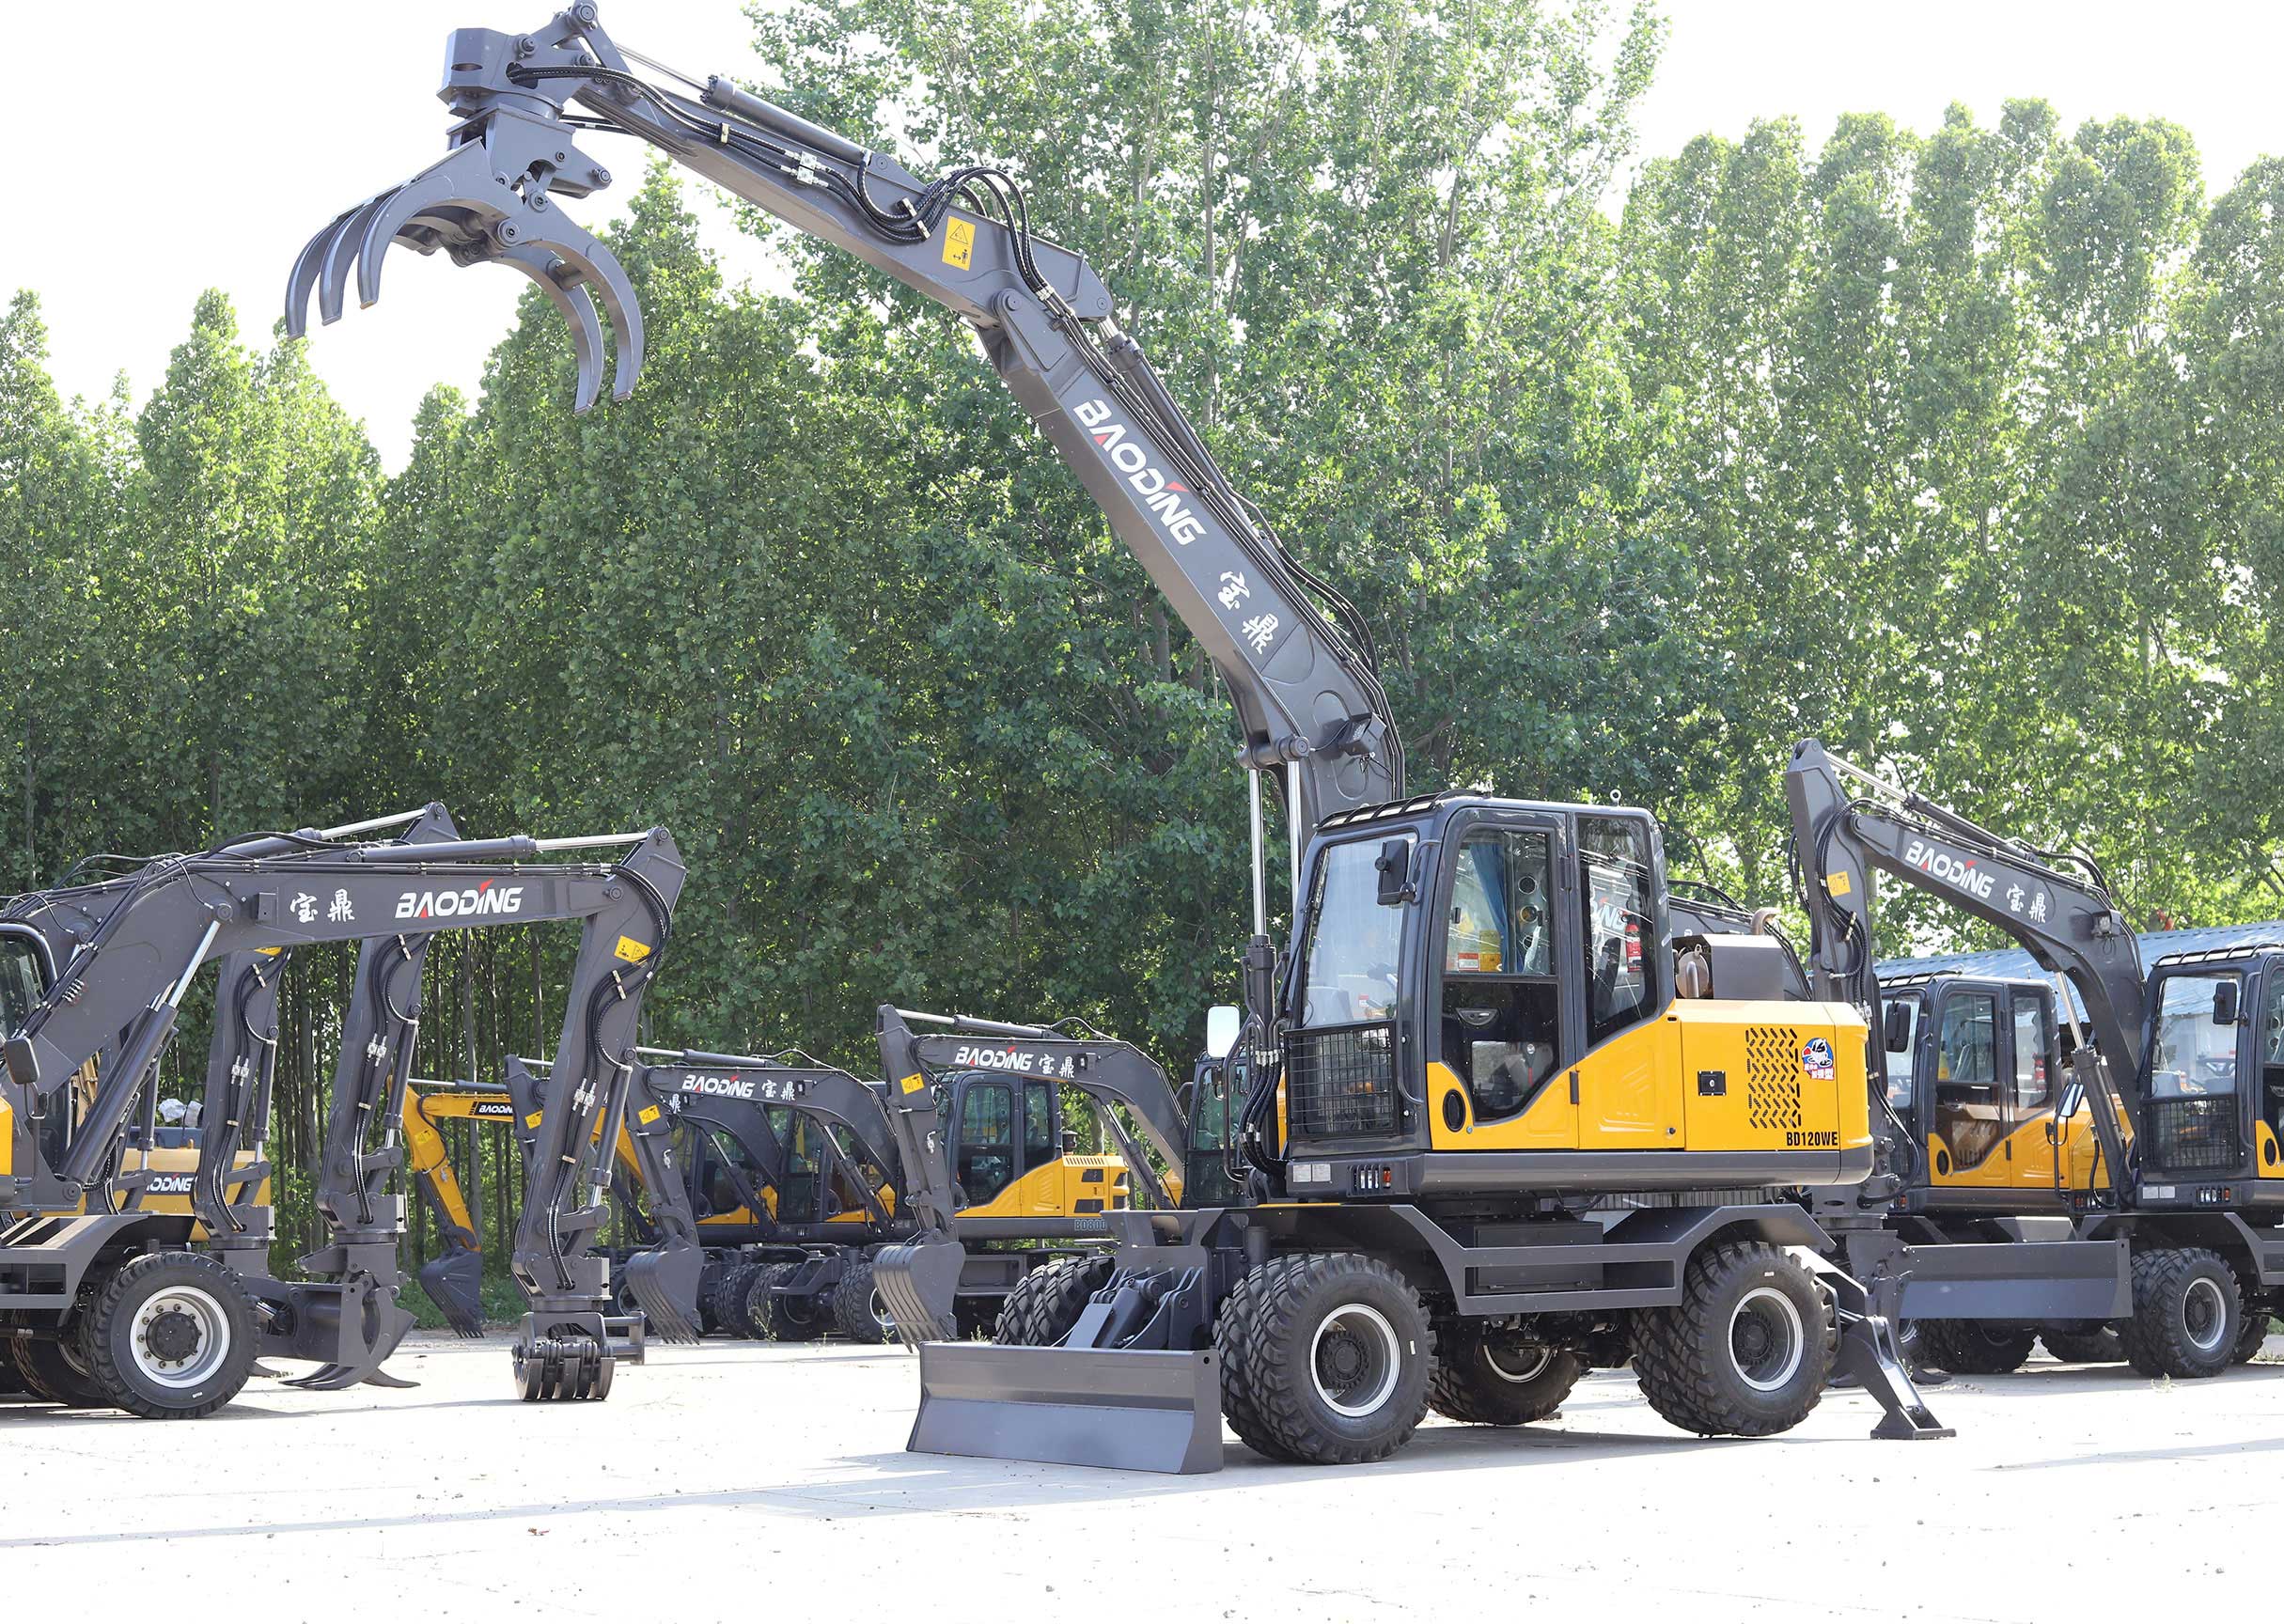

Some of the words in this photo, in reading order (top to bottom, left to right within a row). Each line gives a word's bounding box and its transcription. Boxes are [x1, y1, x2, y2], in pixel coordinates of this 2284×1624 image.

[1073, 399, 1207, 545] BAODING
[1904, 841, 1995, 898] BAODING
[289, 888, 355, 923] 宝鼎
[395, 878, 524, 918] BAODING
[954, 1045, 1034, 1070] BAODING
[681, 1074, 755, 1098] BAODING
[478, 1103, 513, 1114] BAODIN
[1787, 1132, 1838, 1146] BD120WE
[146, 1173, 194, 1192] ODING
